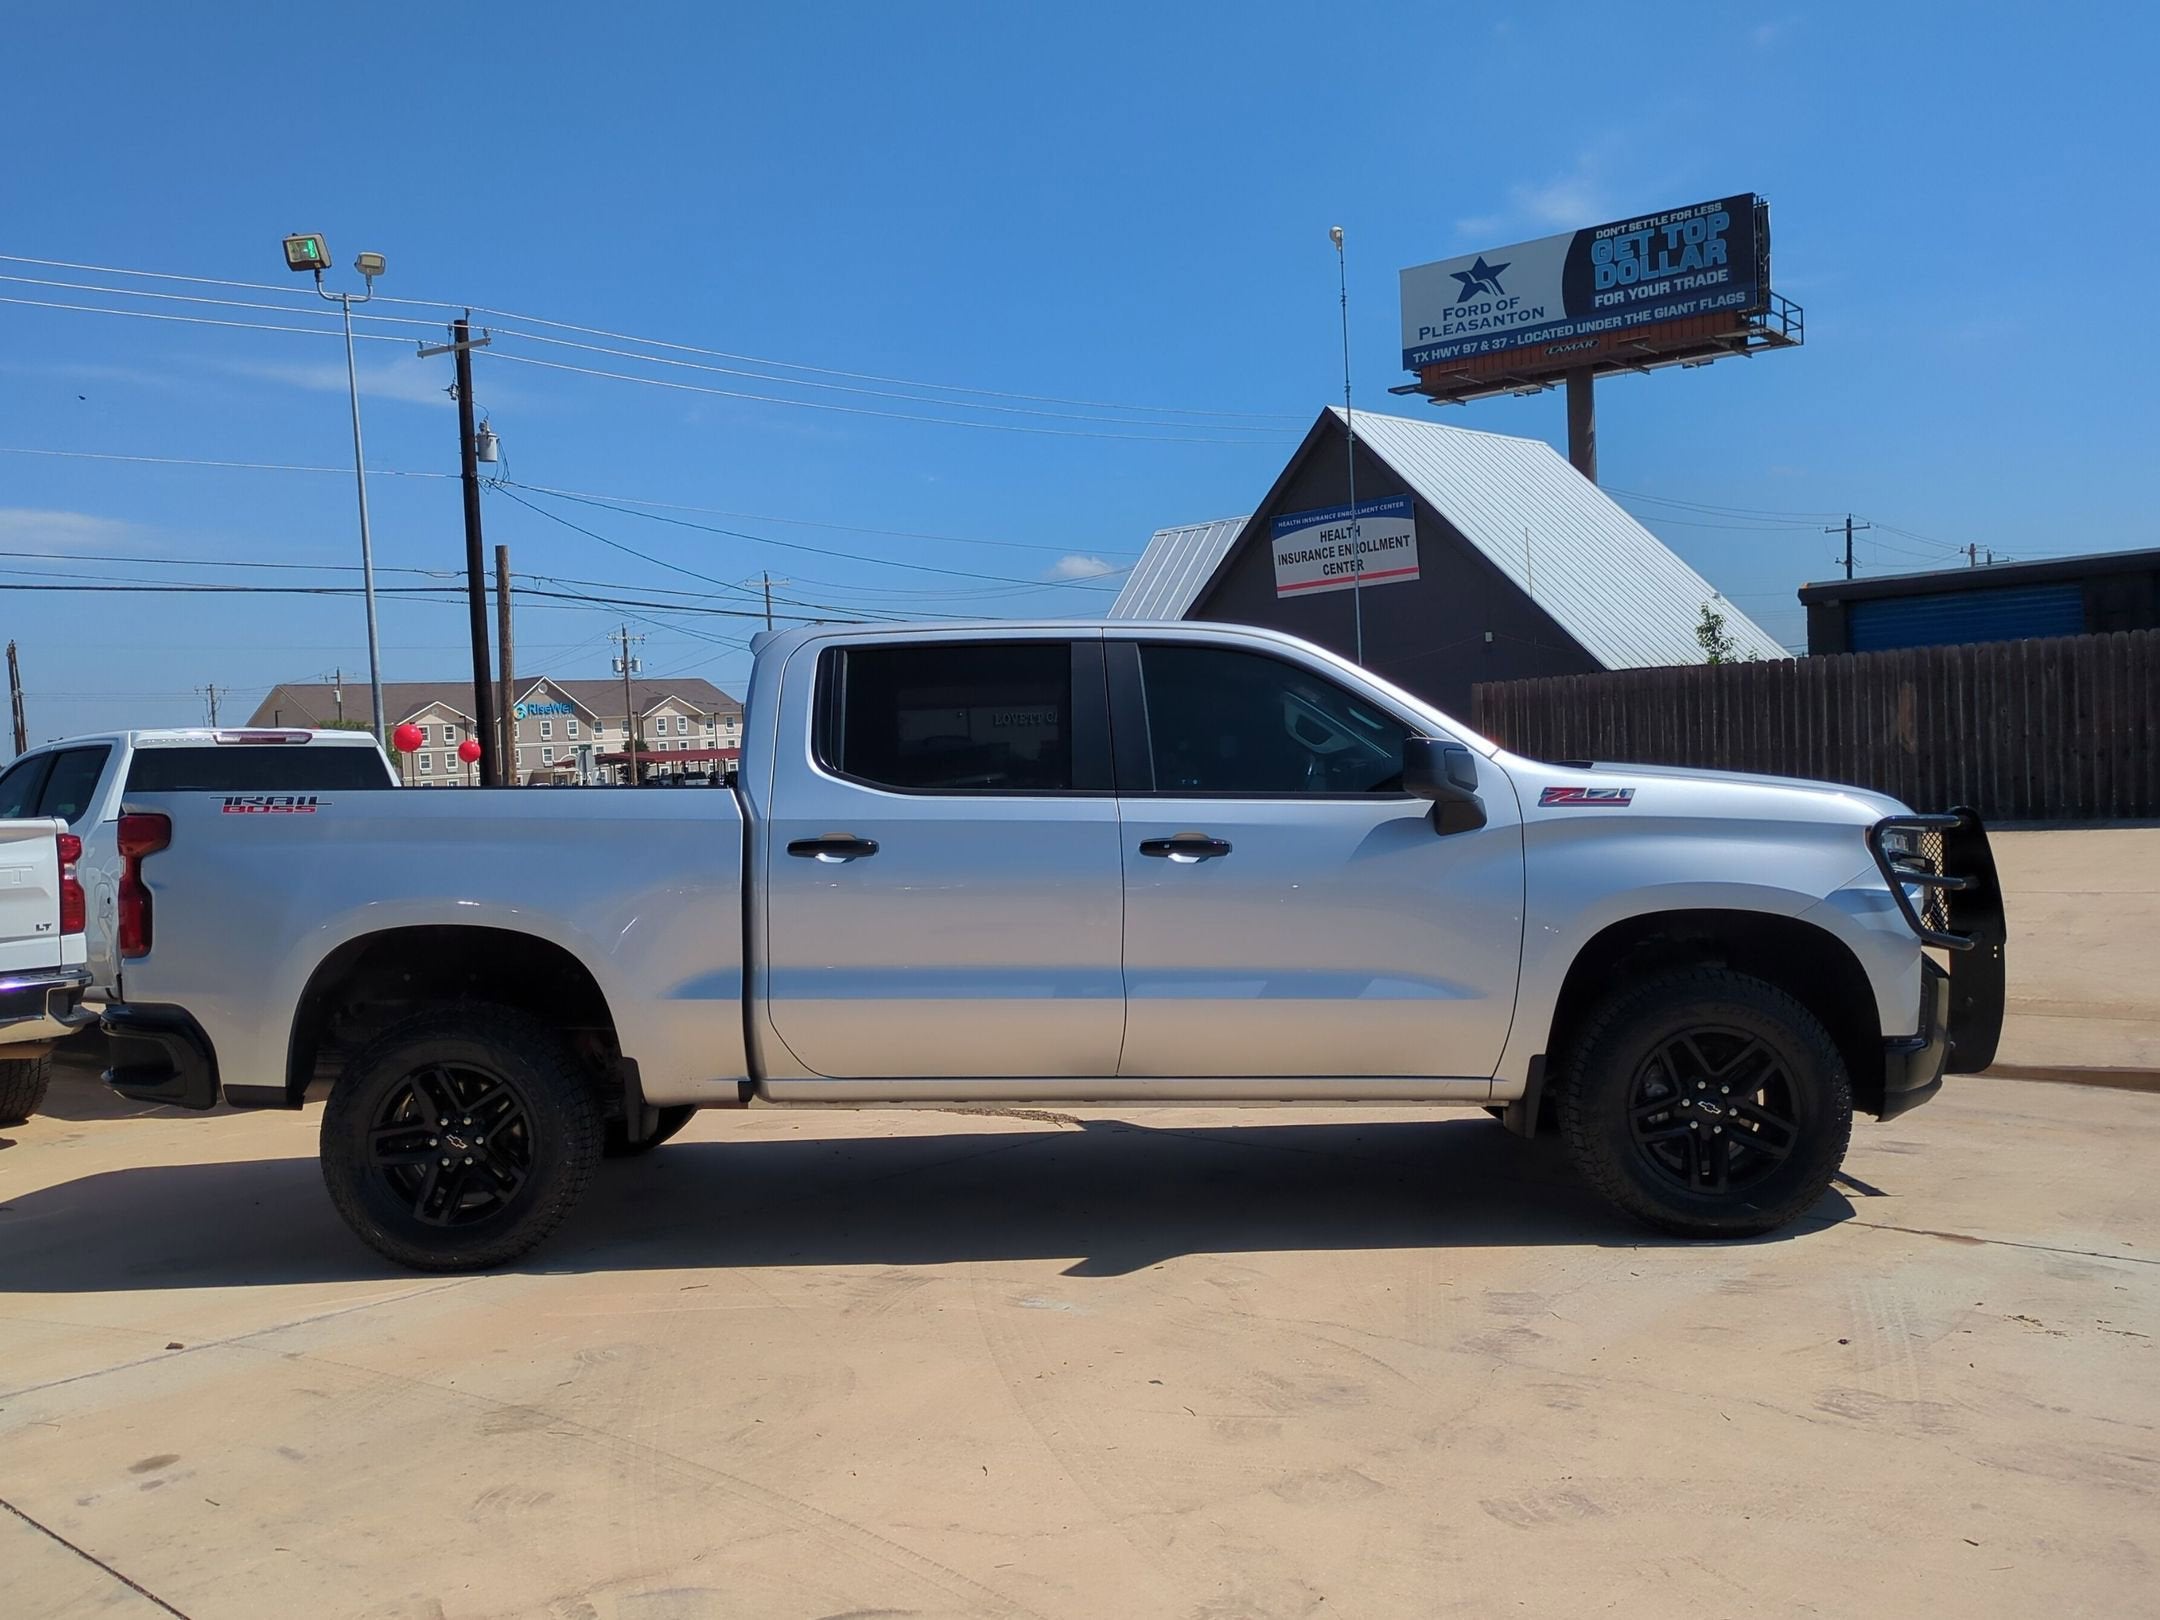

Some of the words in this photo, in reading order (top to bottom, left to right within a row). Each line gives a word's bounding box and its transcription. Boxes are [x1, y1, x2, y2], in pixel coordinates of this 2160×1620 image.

[1596, 224, 1627, 240] DON'T
[1629, 215, 1669, 232] SETTLE
[1670, 209, 1692, 223] FOR
[1694, 202, 1722, 217] LESS
[1591, 228, 1655, 265] GET
[1661, 211, 1730, 250] TOP
[1594, 238, 1727, 290] DOLLAR
[1594, 290, 1625, 308] FOR
[1628, 281, 1671, 301] YOUR
[1673, 269, 1729, 290] TRADE
[1442, 302, 1492, 321] FORD
[1496, 296, 1521, 315] OF
[1413, 351, 1429, 363] TX
[1431, 344, 1460, 360] HWY
[1463, 342, 1478, 354] 97
[1480, 340, 1490, 351] &
[1492, 337, 1507, 349] 37
[1517, 324, 1574, 345] LOCATED
[1577, 316, 1622, 333] UNDER
[1624, 309, 1652, 325] THE
[1654, 301, 1697, 319] GIANT
[1700, 291, 1746, 309] FLAGS
[1419, 306, 1545, 340] PLEASANTON
[1279, 519, 1301, 528] HEALTH
[1302, 512, 1336, 524] INSURANCE
[1380, 500, 1404, 511] CENTER
[1320, 525, 1361, 543] HEALTH
[1278, 546, 1336, 566] INSURANCE
[1322, 559, 1365, 576] CENTER
[209, 796, 333, 806] TRAIL
[222, 806, 317, 814] BOSS
[35, 922, 52, 932] LT
